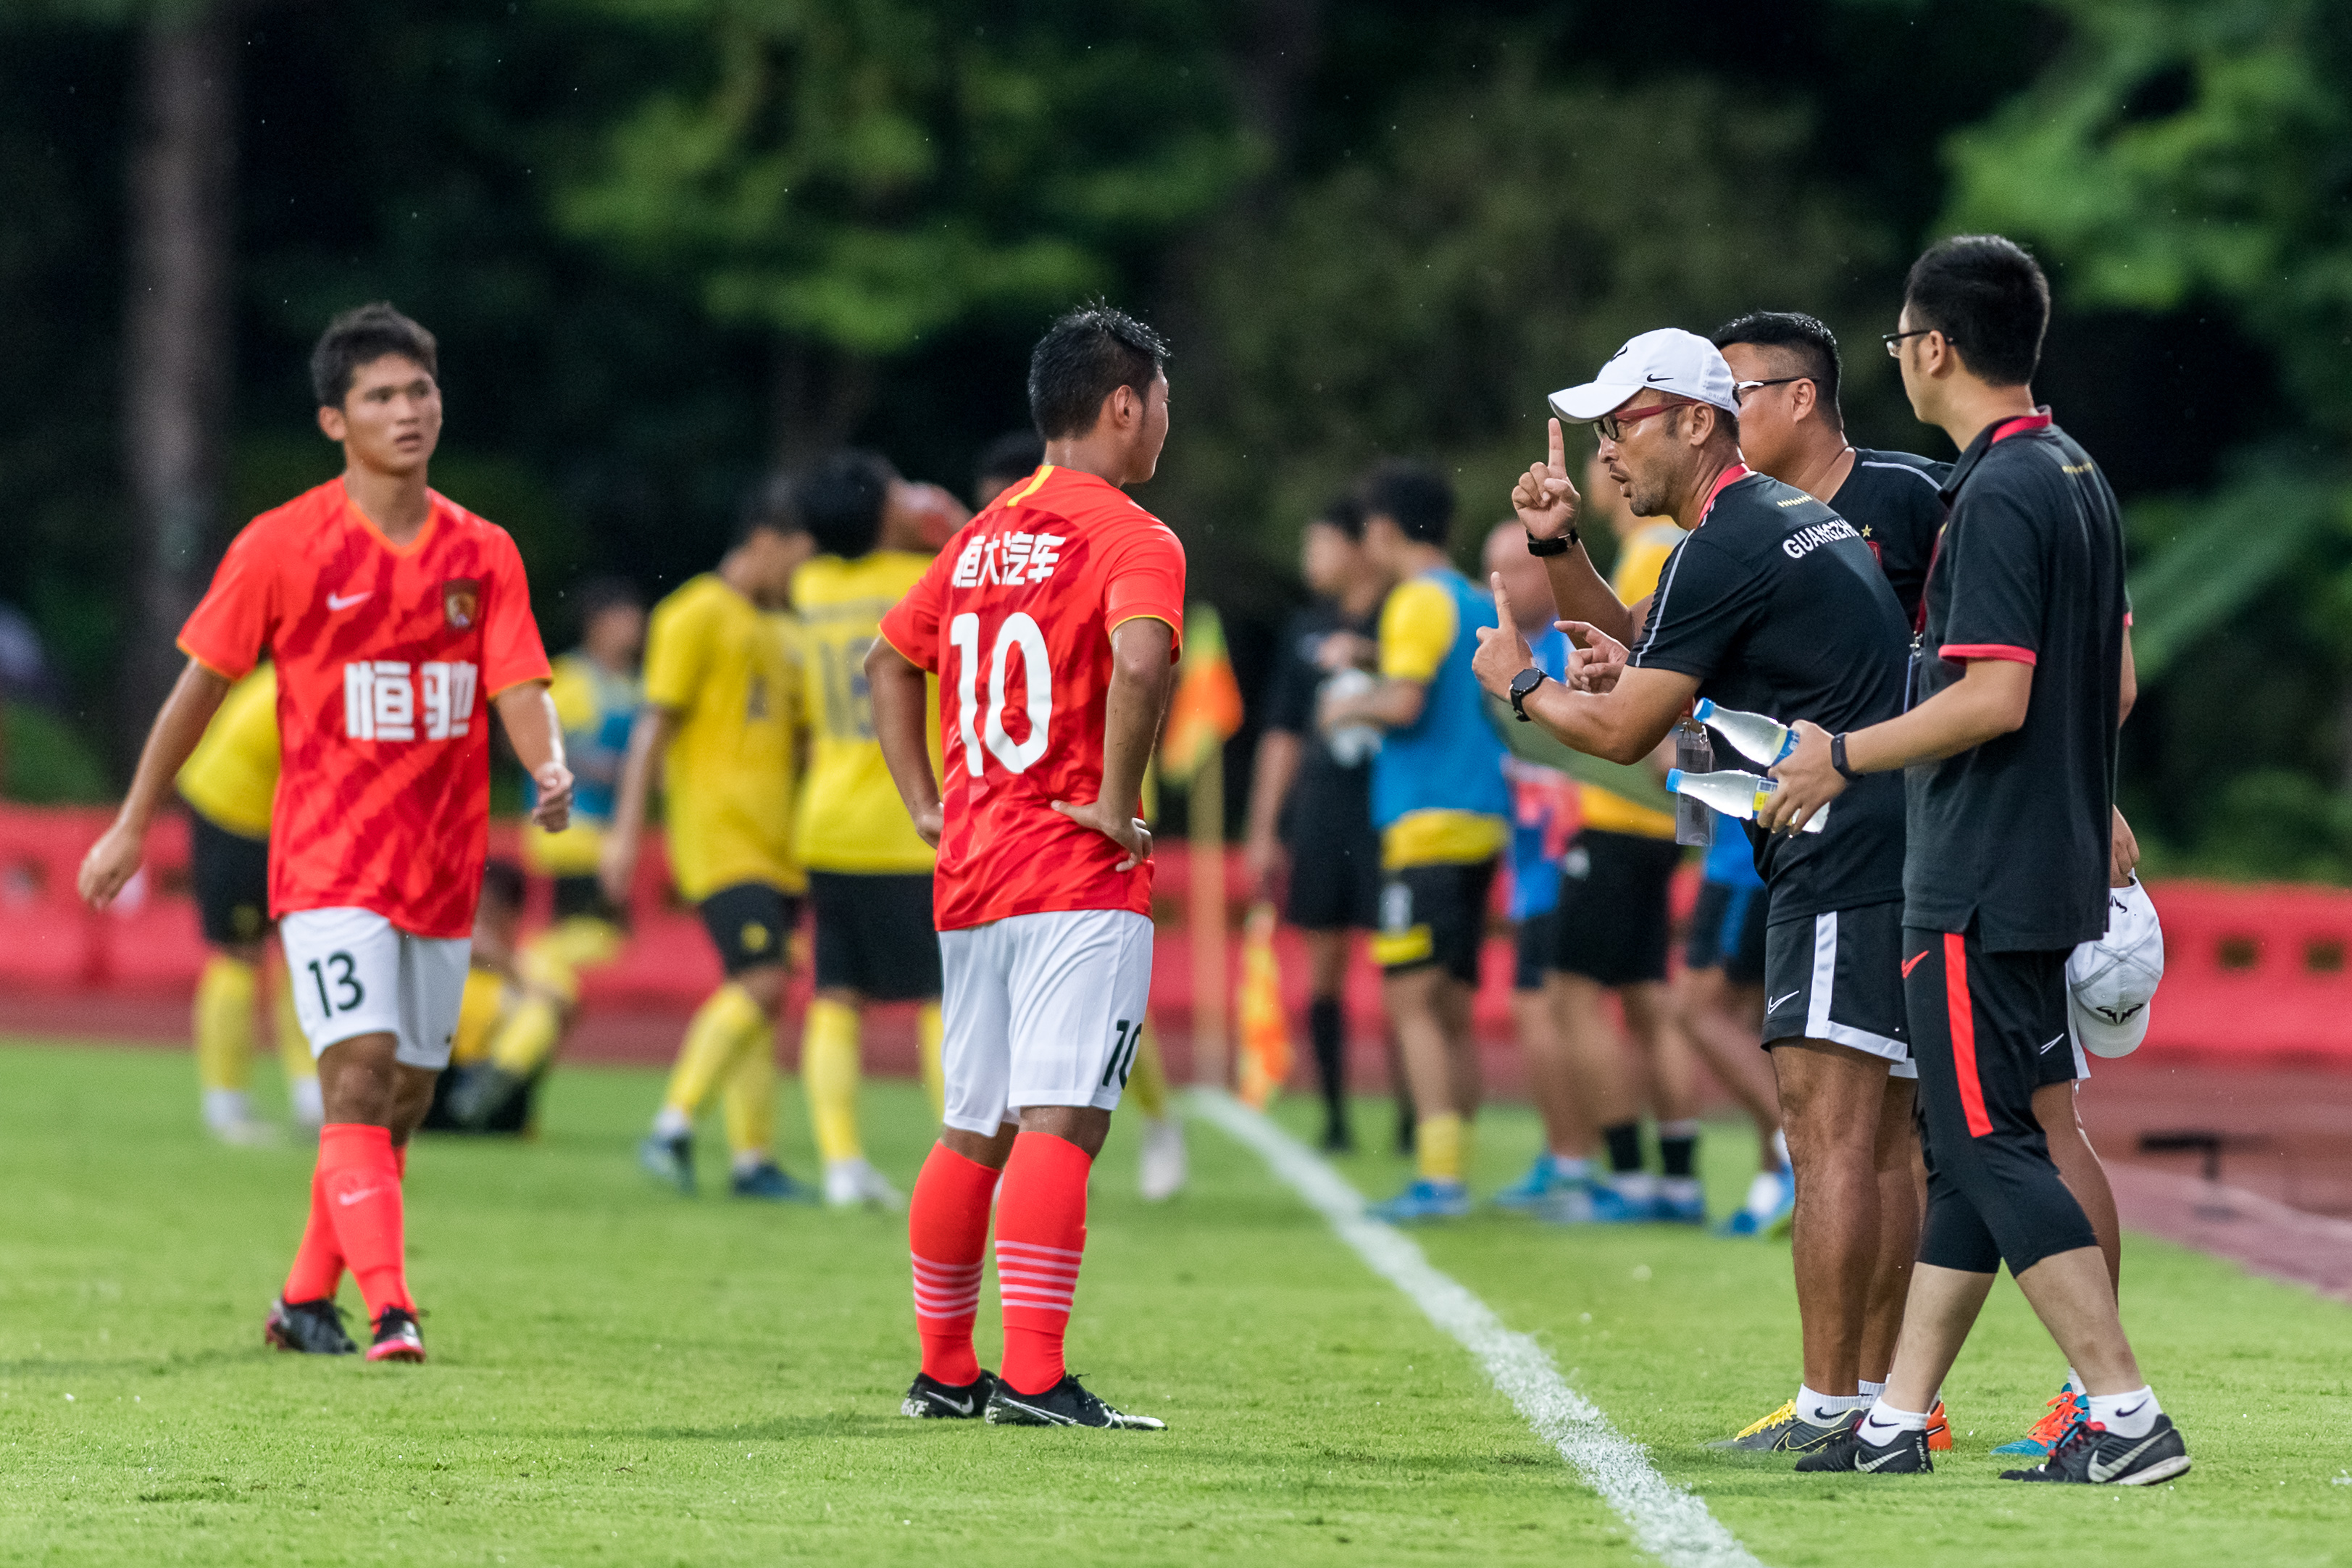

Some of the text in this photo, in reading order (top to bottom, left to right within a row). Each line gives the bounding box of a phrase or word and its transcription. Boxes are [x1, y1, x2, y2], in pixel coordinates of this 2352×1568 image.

[952, 531, 1067, 588] 恒大汽车
[1782, 519, 1860, 559] GUANGZH
[345, 661, 478, 741] 恒驰
[951, 612, 1052, 777] 10
[308, 951, 365, 1017] 13
[1916, 1435, 1927, 1469] TIEMPO
